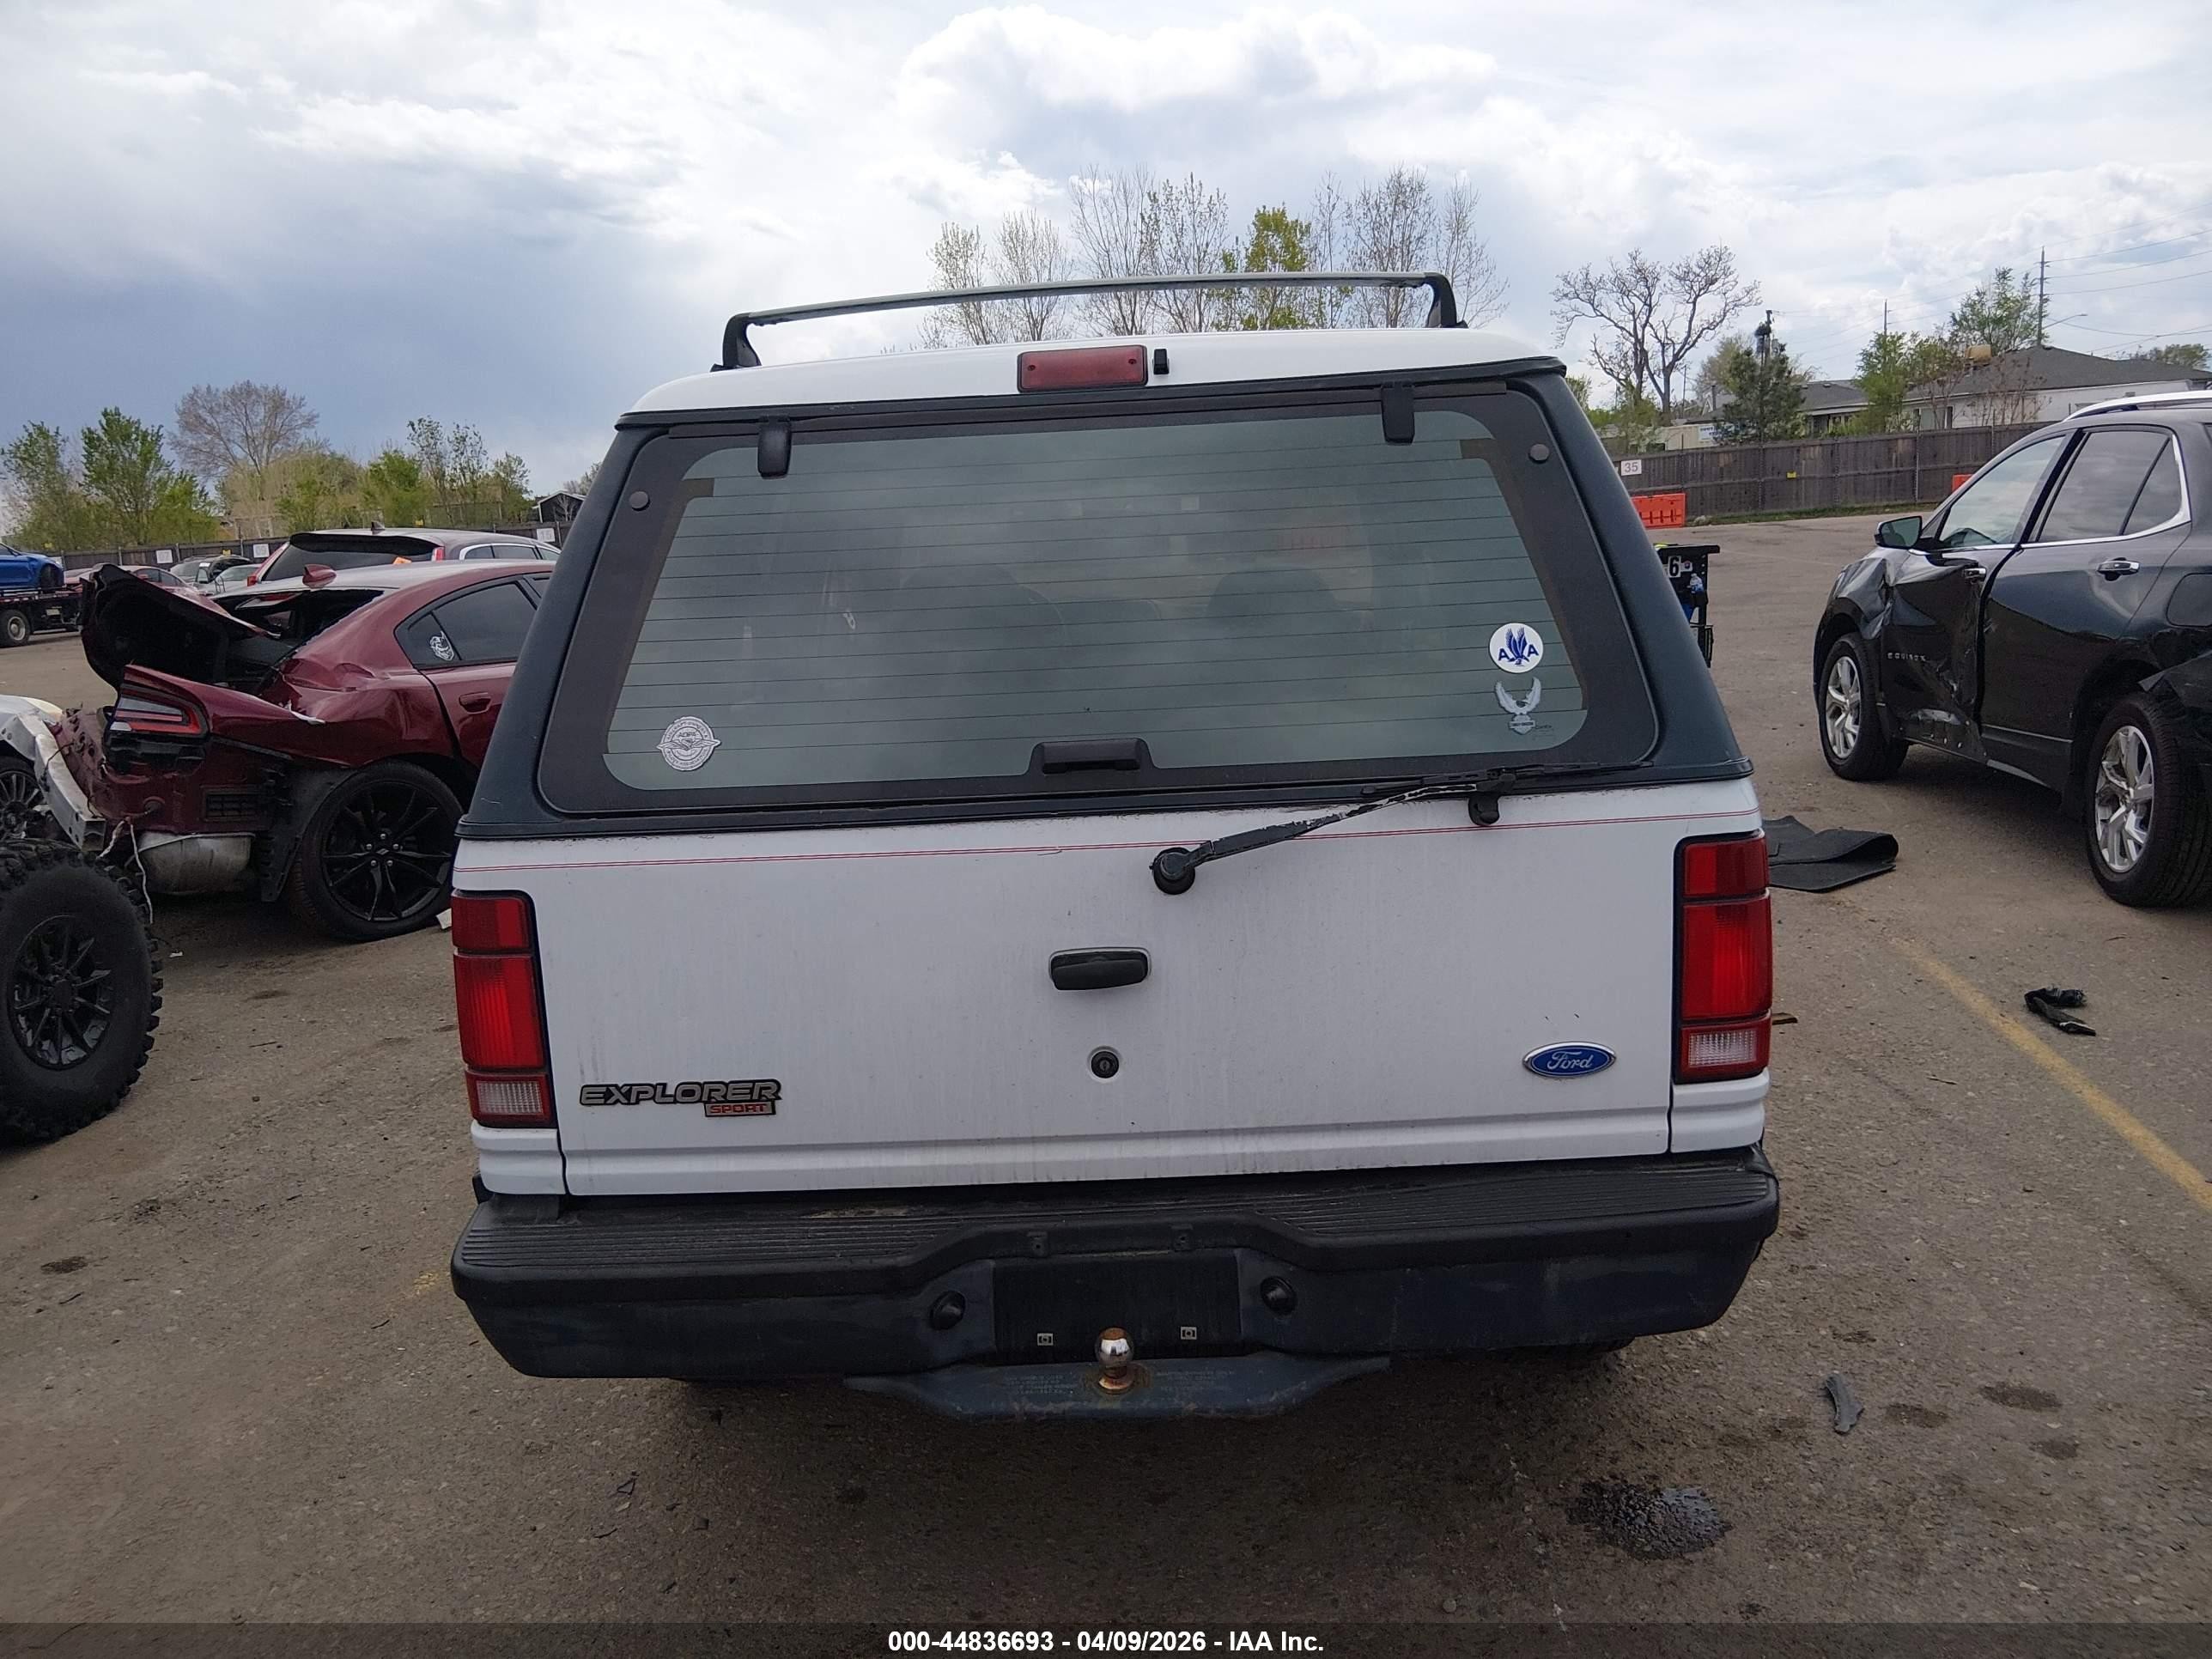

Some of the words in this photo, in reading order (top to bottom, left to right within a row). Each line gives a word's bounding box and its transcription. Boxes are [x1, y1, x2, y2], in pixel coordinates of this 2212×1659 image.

[1624, 462, 1638, 473] 35
[1547, 1051, 1594, 1070] Ford
[580, 1080, 781, 1104] EXPLORER
[709, 1103, 768, 1114] SPORT
